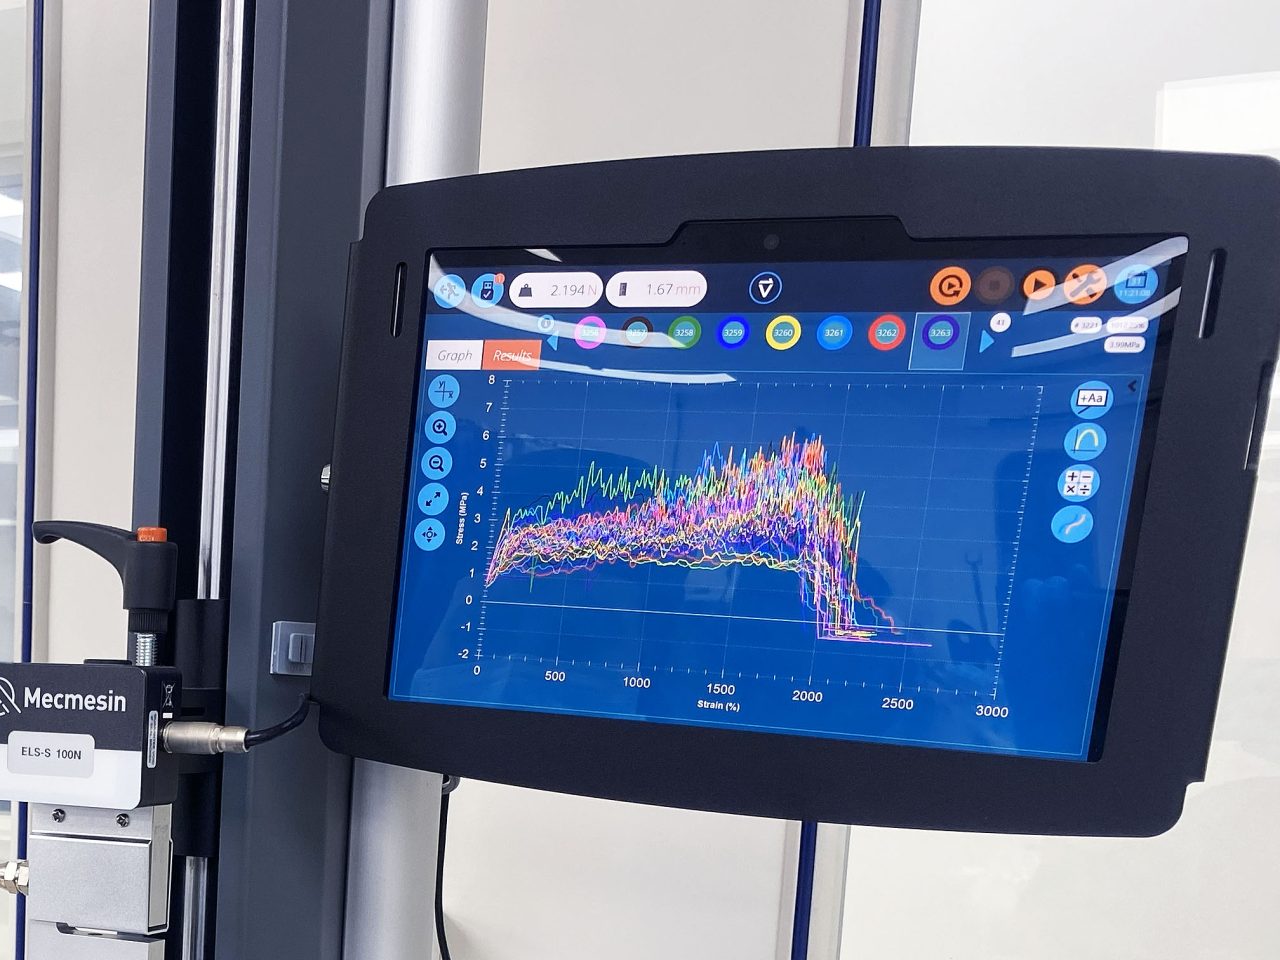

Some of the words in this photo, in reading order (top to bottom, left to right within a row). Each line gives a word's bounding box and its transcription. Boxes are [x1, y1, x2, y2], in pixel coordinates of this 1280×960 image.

[551, 284, 585, 297] 2.194
[587, 284, 598, 296] N
[647, 283, 673, 295] 1.67
[675, 286, 701, 295] mm
[675, 328, 694, 337] 3258
[723, 328, 743, 337] 3259
[773, 328, 793, 337] 3260
[824, 327, 844, 338] 3261
[876, 327, 897, 338] 3262
[929, 327, 951, 338] 3263
[437, 349, 473, 363] Graph
[492, 349, 533, 361] Results
[488, 374, 495, 385] 8
[486, 402, 493, 412] 7
[482, 430, 490, 441] 6
[479, 458, 487, 469] 5
[476, 485, 484, 496] 4
[458, 492, 470, 516] (MPa)
[473, 513, 481, 523] 3
[455, 517, 466, 545] Stress
[470, 540, 479, 551] 2
[469, 568, 475, 578] 1
[465, 595, 473, 605] 0
[460, 622, 471, 632] -1
[458, 649, 469, 659] -2
[473, 665, 481, 676] 0
[544, 670, 566, 682] 500
[623, 676, 651, 689] 1000
[706, 683, 736, 695] 1500
[24, 686, 126, 712] Mecmesin
[792, 690, 823, 703] 2000
[697, 699, 724, 711] Strain
[725, 701, 741, 713] (%)
[881, 697, 914, 710] 2500
[975, 705, 1009, 718] 3000
[21, 747, 51, 758] ELS-S
[56, 749, 82, 760] 100N
